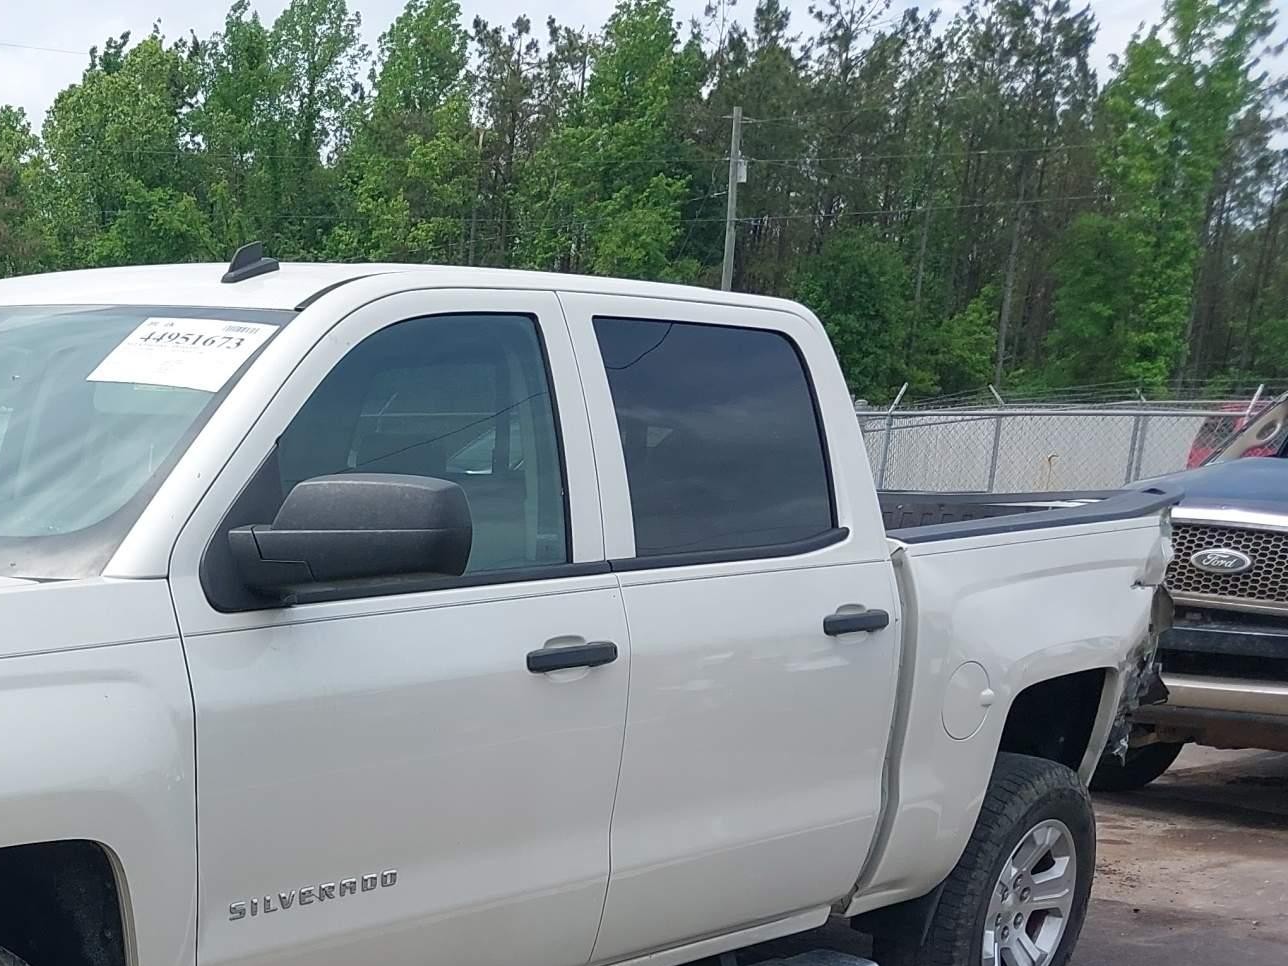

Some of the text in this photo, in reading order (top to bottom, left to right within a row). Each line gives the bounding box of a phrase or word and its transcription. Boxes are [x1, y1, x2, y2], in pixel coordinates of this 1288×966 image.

[139, 331, 245, 349] 44951673
[1203, 554, 1237, 568] Ford
[228, 869, 398, 921] SILVERADO
